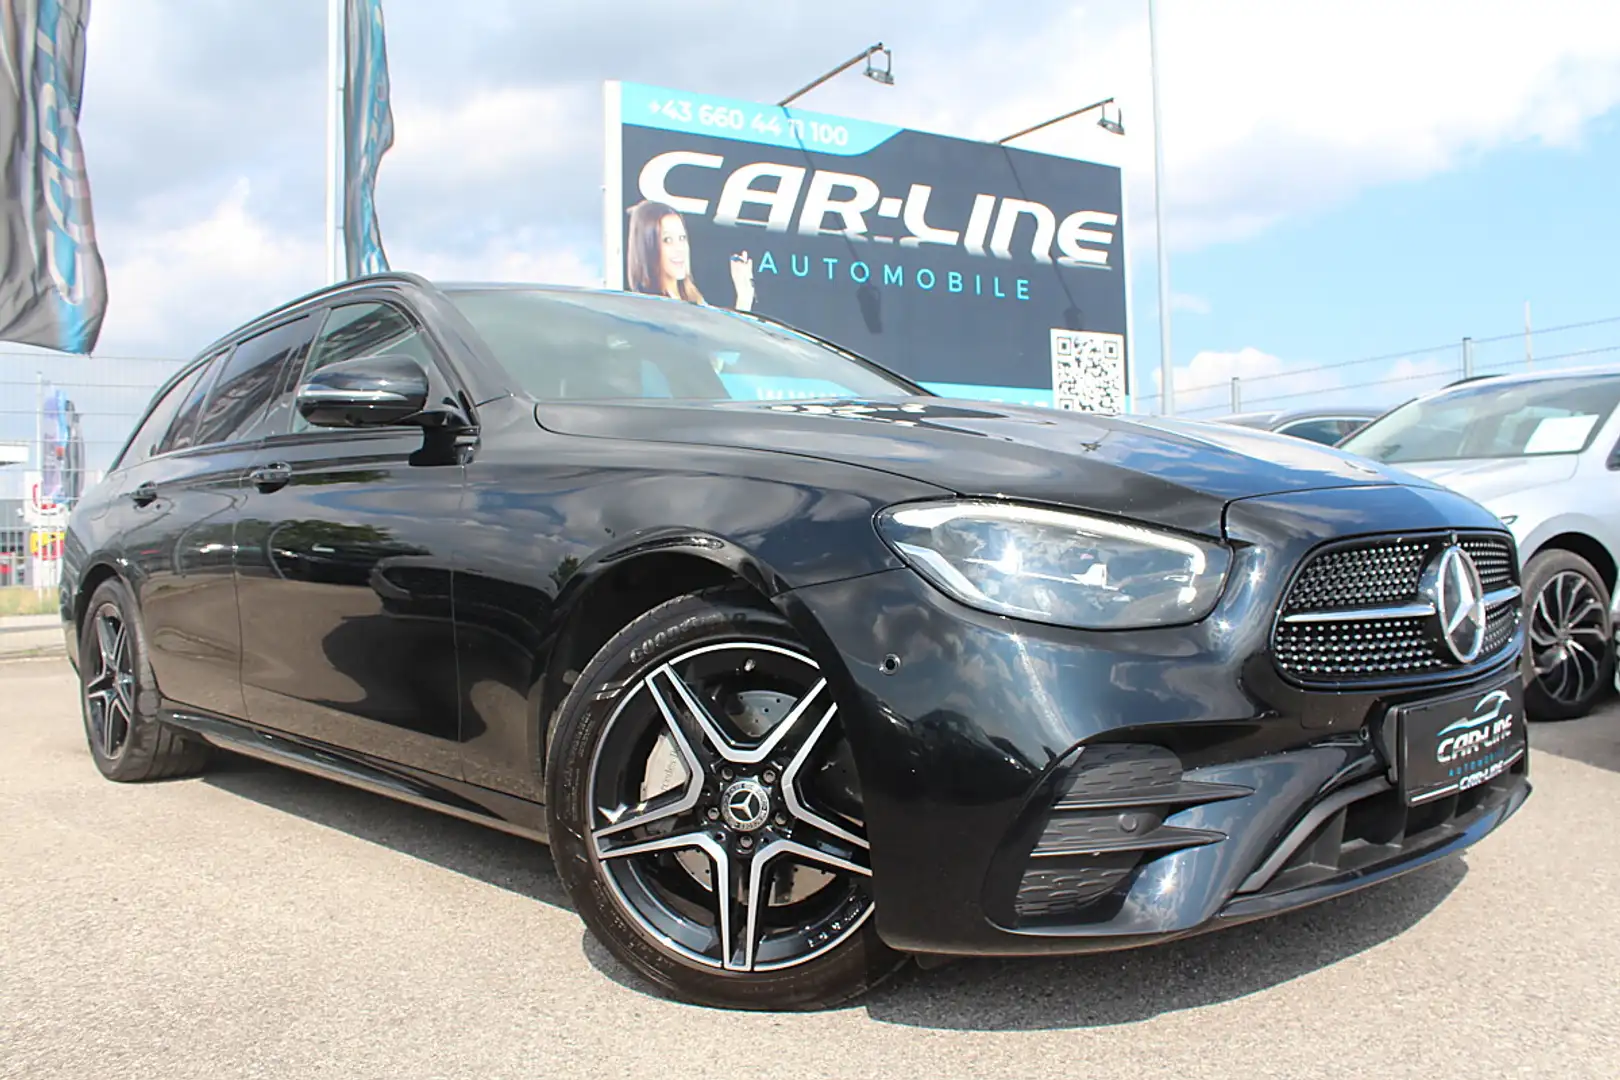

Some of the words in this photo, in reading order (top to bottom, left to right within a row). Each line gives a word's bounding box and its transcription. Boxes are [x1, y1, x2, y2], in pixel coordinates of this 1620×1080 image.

[648, 100, 692, 122] +43
[699, 105, 744, 130] 660
[752, 112, 782, 137] 44
[787, 118, 805, 139] 11
[810, 121, 848, 146] 100
[638, 150, 1119, 267] CAR-LINE
[757, 250, 1031, 301] AUTOMOBILE
